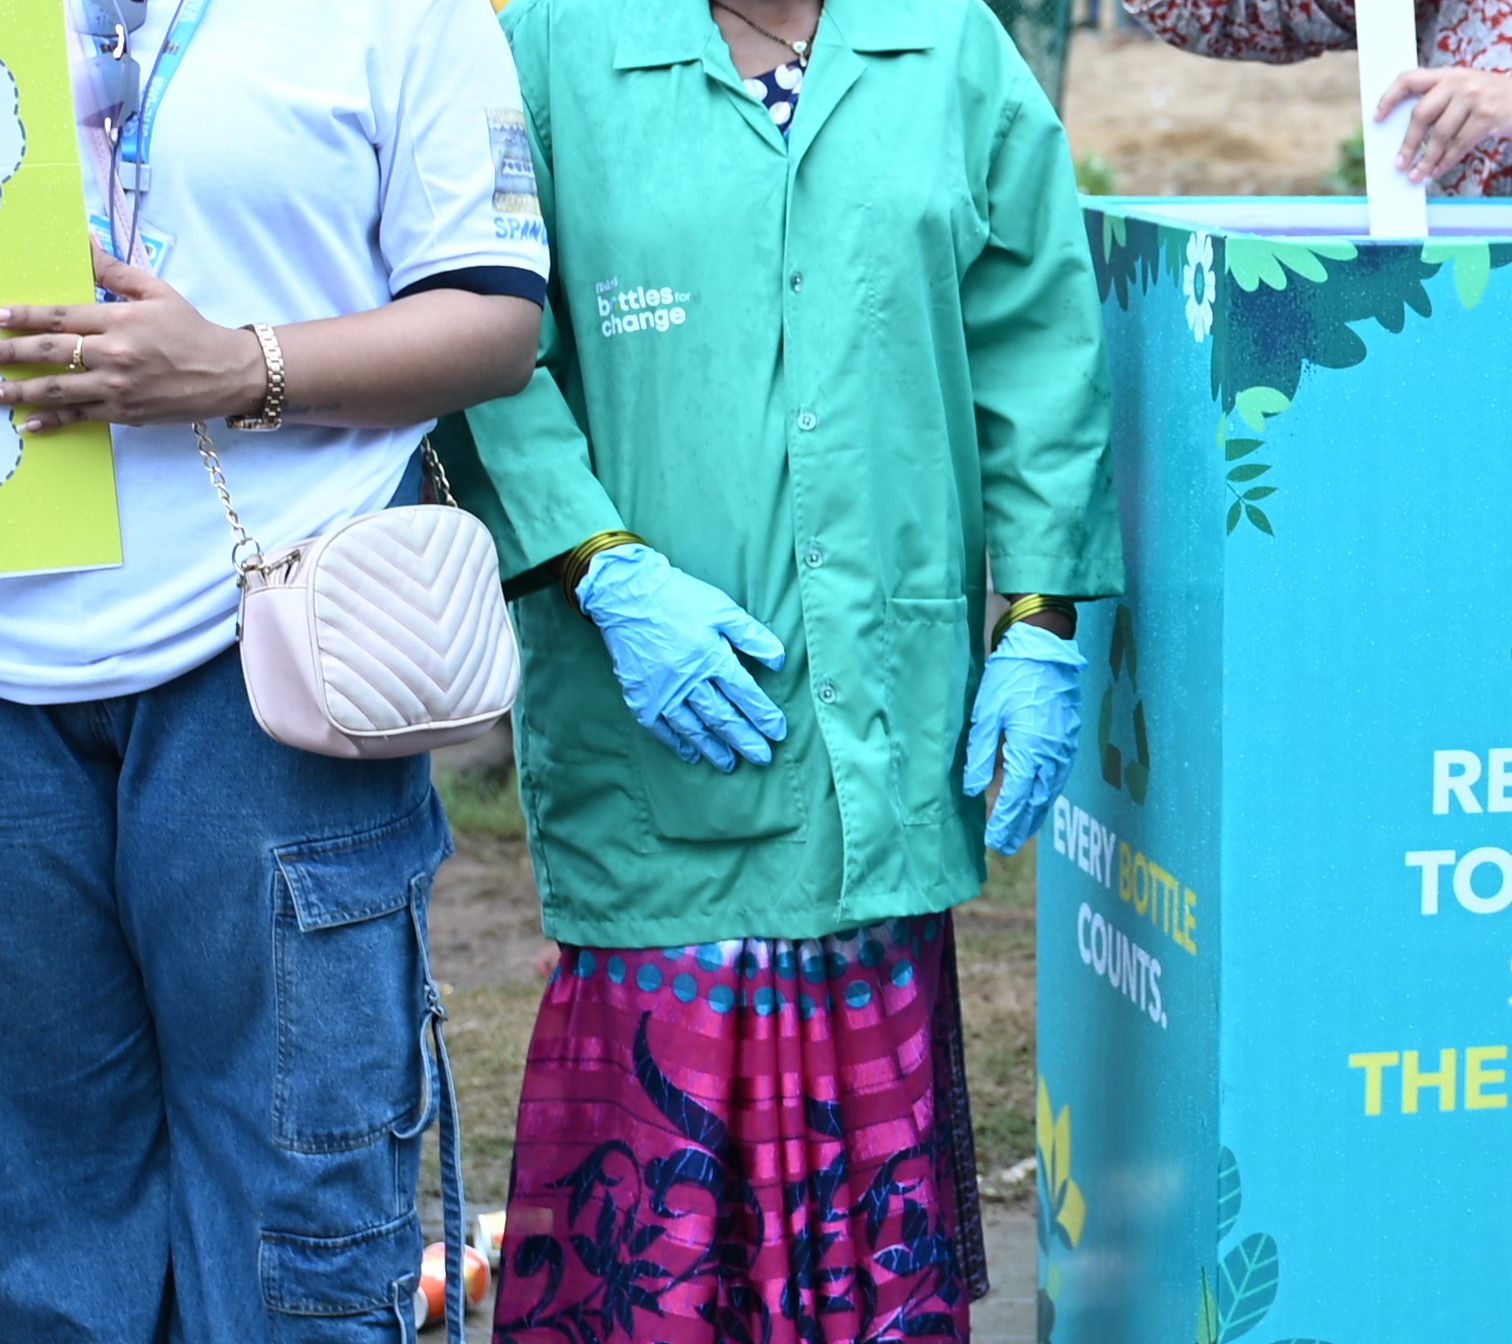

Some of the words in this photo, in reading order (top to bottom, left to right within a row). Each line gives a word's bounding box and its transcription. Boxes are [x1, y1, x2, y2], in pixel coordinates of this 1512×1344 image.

[601, 306, 687, 338] change
[1053, 794, 1117, 889] EVERY
[1119, 838, 1198, 956] BOTTLE
[1077, 902, 1168, 1030] COUNTS.
[1349, 1045, 1508, 1114] THE
